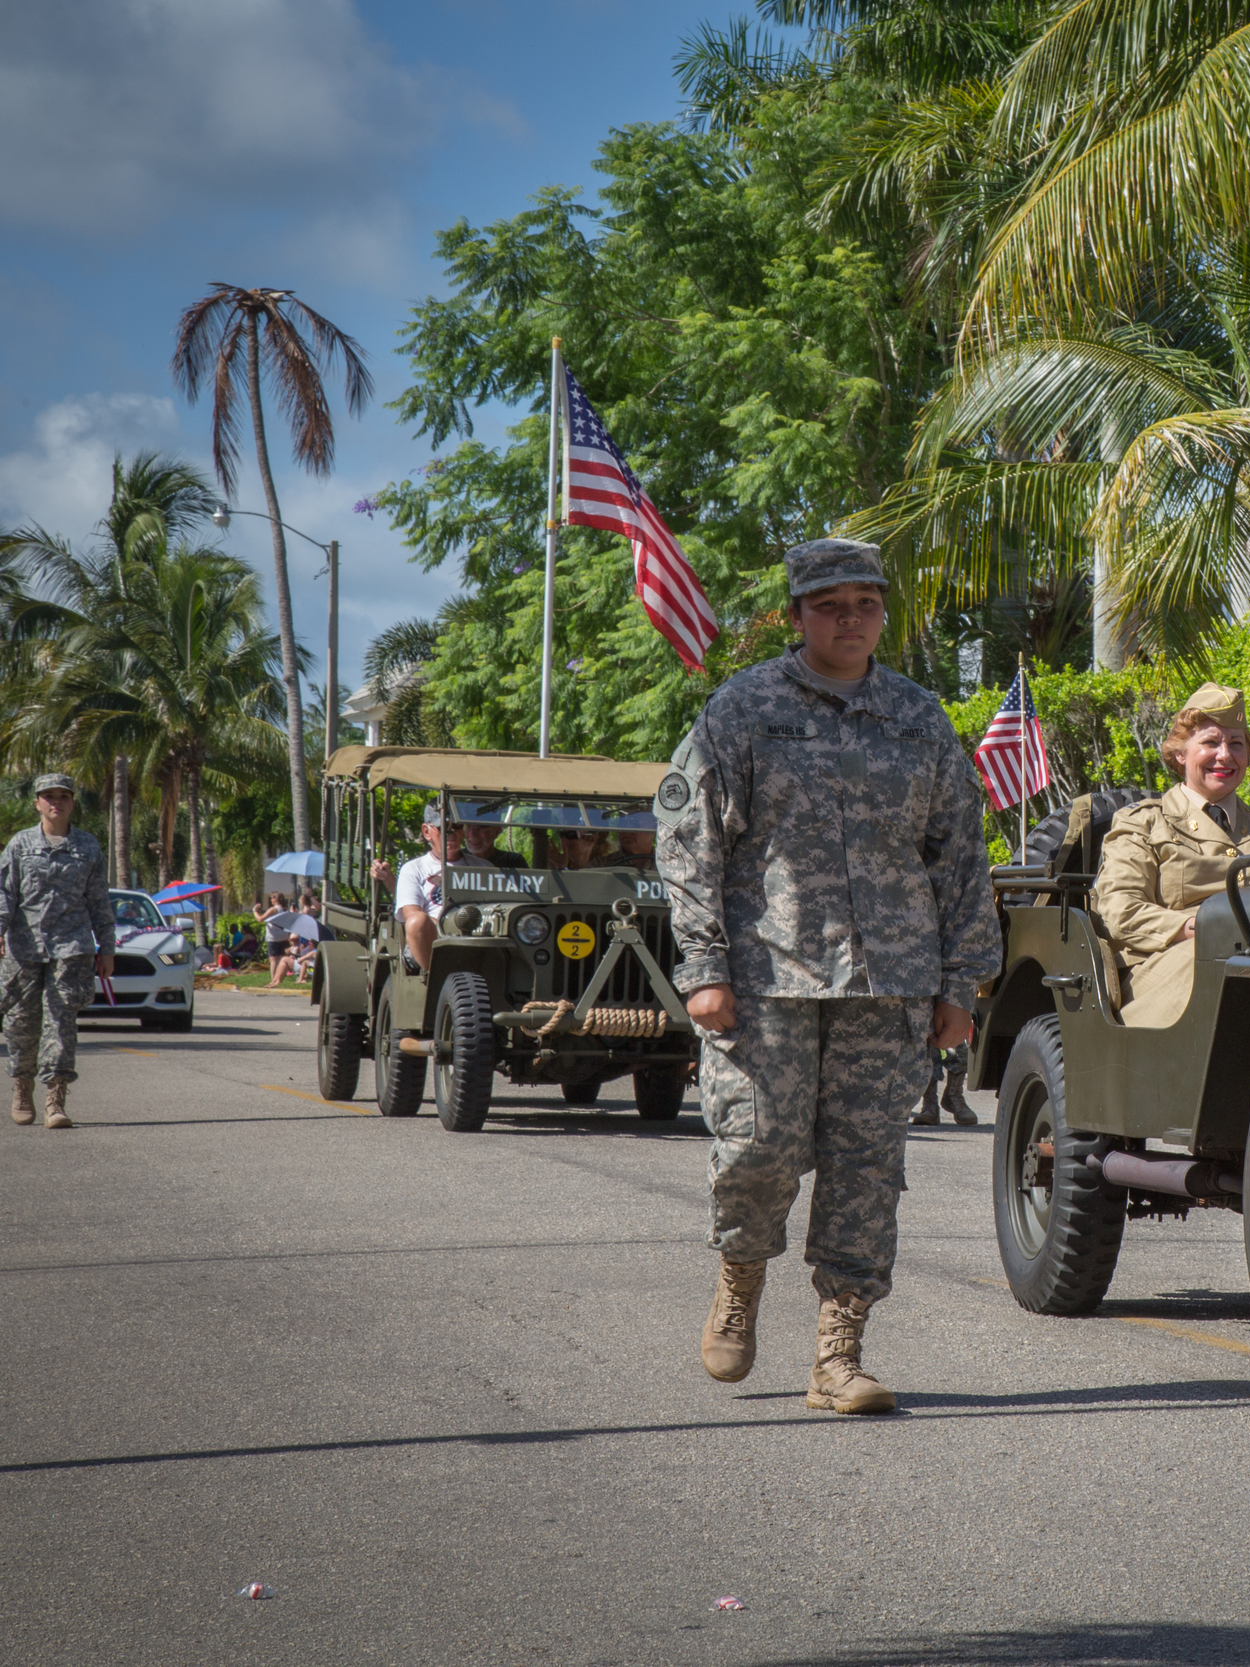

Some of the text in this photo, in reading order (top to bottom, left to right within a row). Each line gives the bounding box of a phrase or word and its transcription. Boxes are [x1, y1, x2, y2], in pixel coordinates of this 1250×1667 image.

[767, 724, 806, 736] NAPLES HS
[900, 727, 926, 738] JROTC
[451, 871, 545, 894] MILITARY
[572, 925, 580, 937] 2
[571, 945, 579, 957] 2
